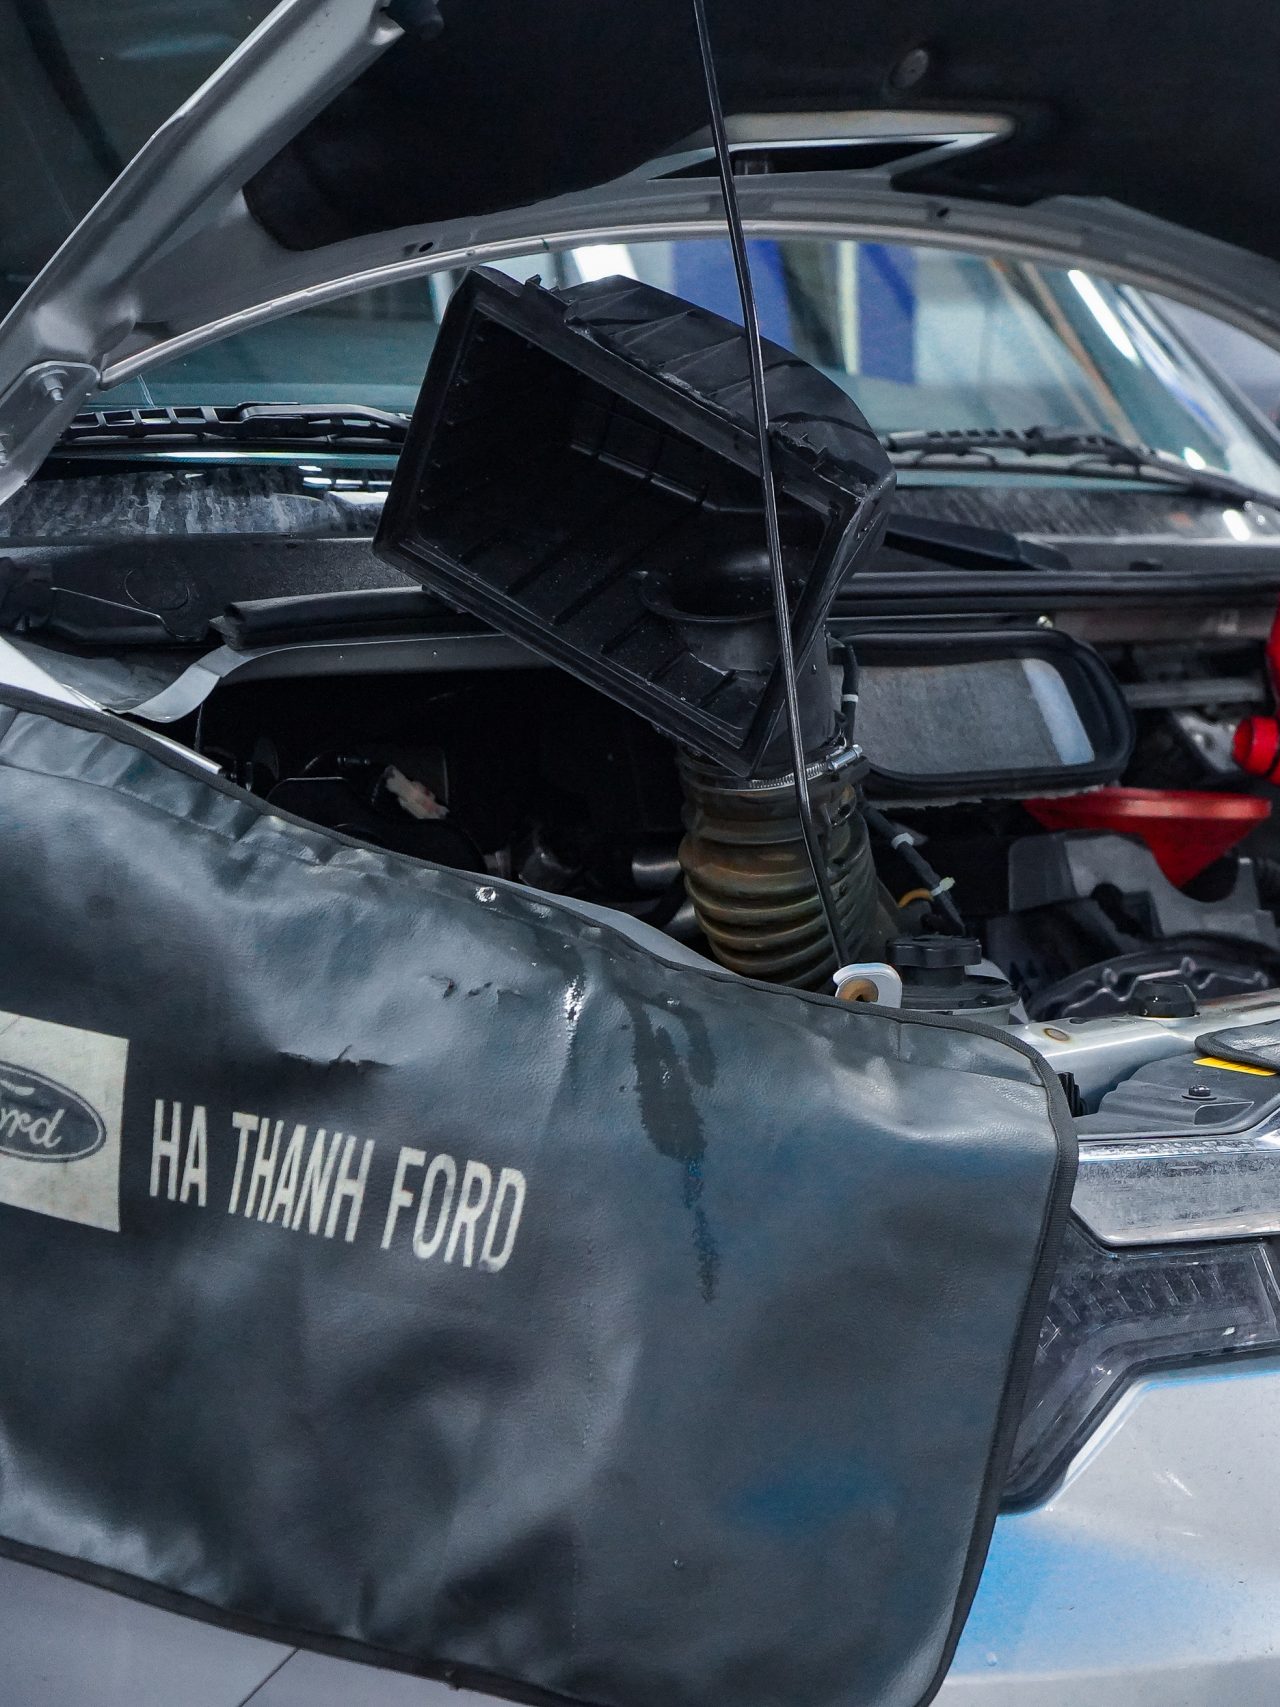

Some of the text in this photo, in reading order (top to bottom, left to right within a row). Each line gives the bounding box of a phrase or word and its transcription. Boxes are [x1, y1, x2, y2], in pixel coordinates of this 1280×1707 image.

[149, 1099, 526, 1274] HA THANH FORD
